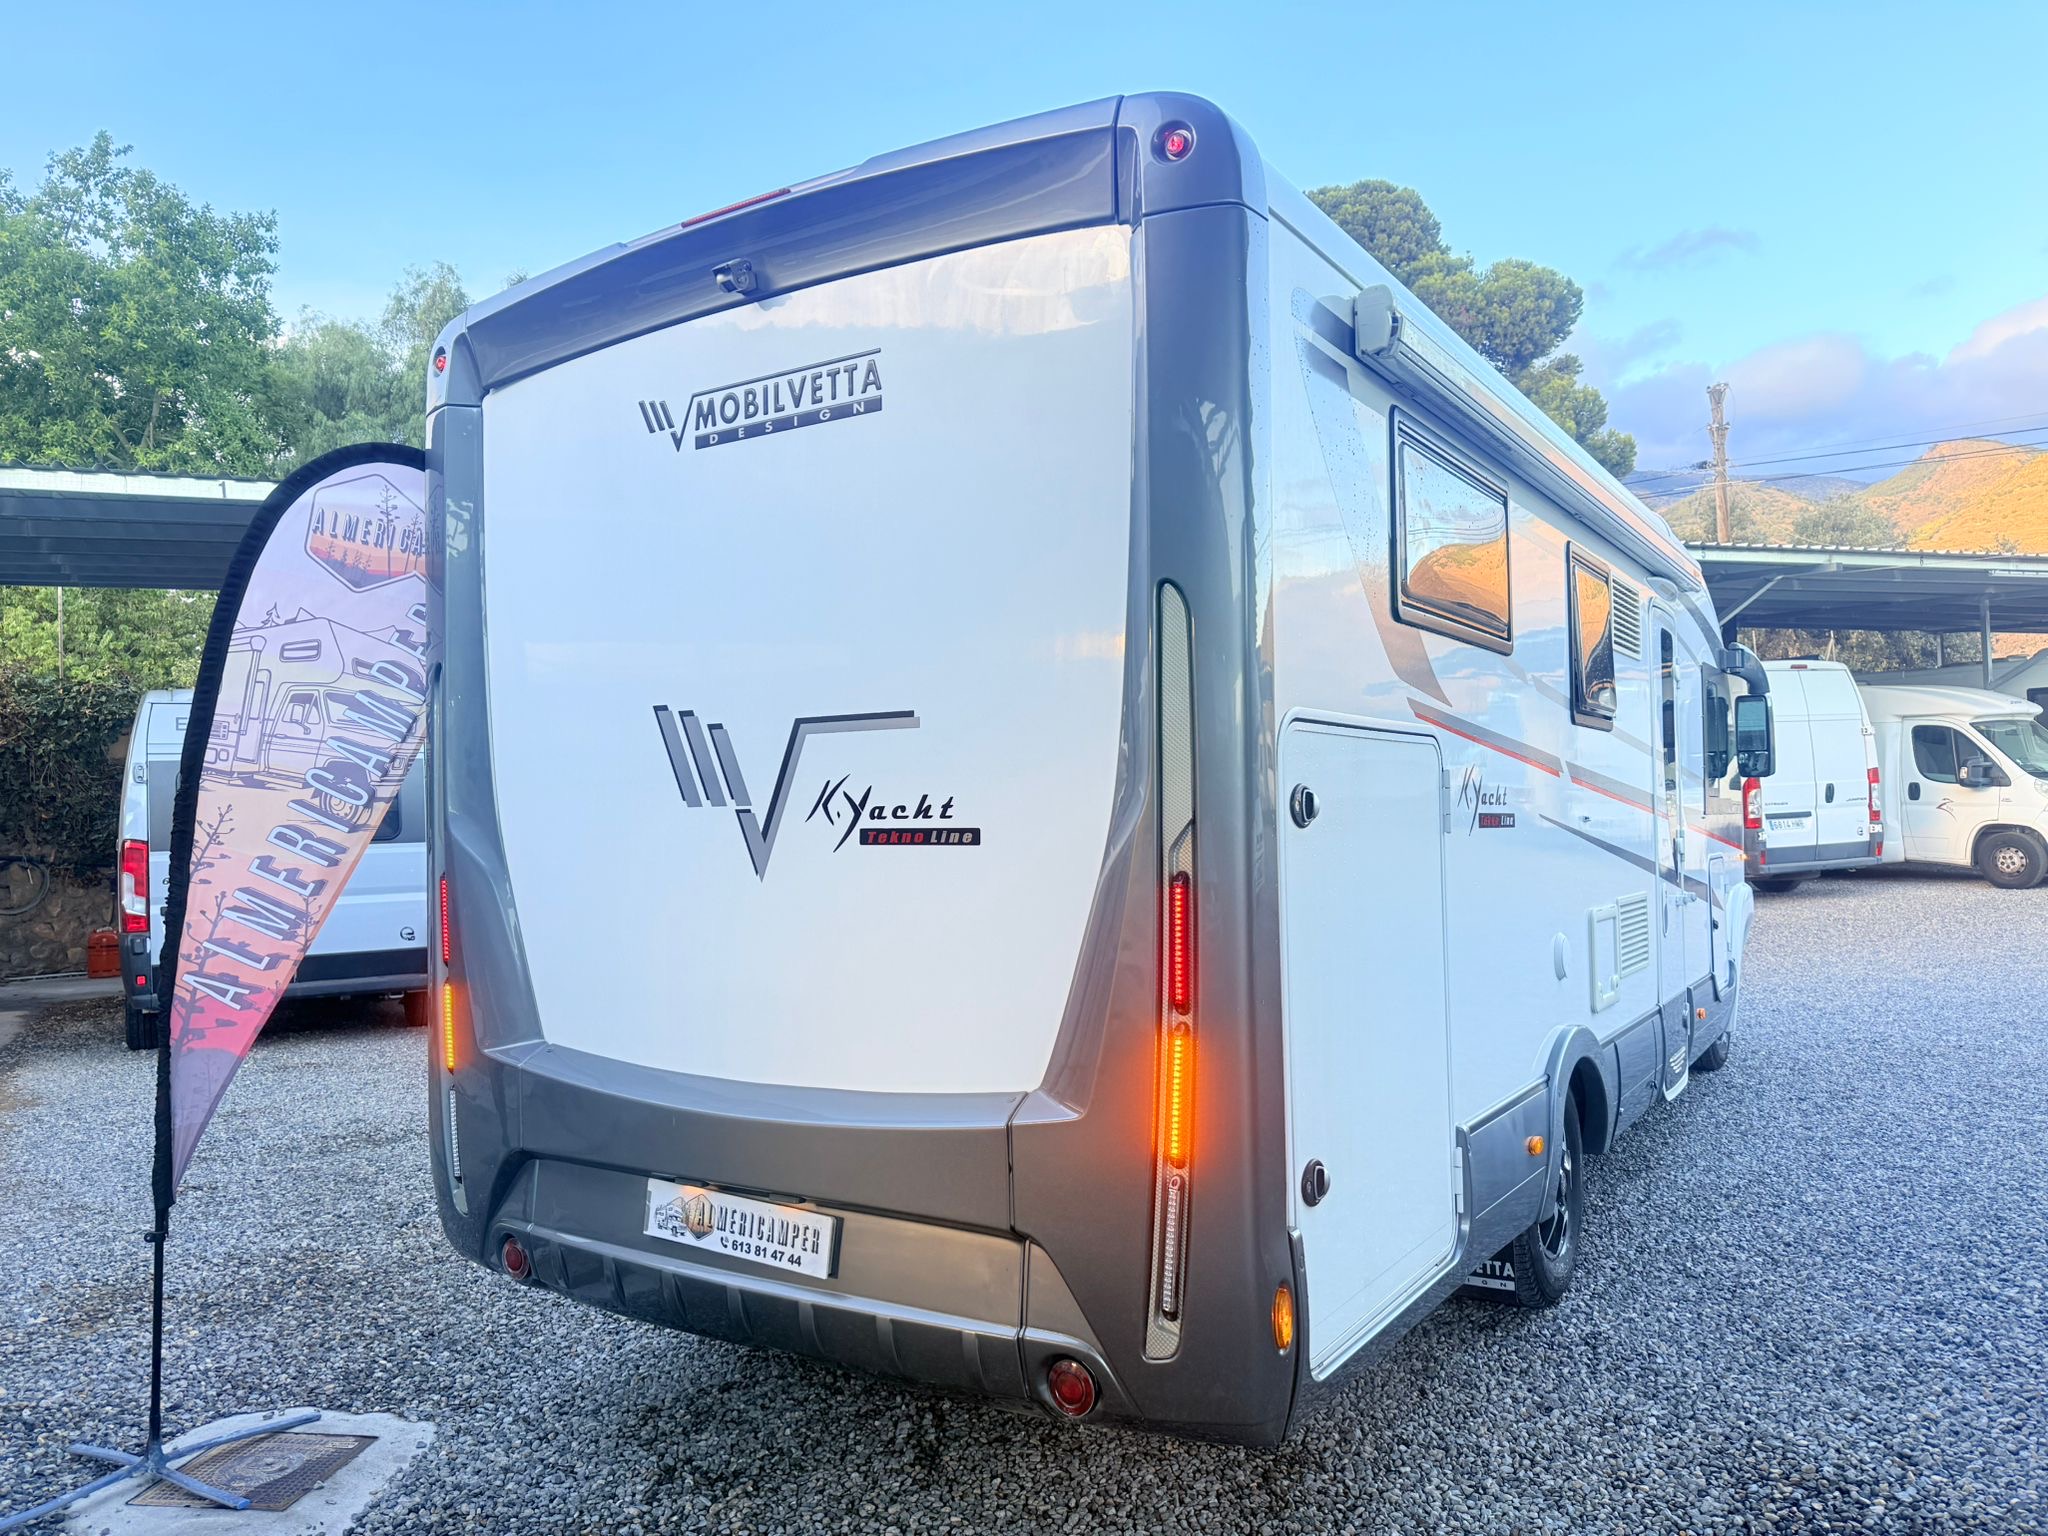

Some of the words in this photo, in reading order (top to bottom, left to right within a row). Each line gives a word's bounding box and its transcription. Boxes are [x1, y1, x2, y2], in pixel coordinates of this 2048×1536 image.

[694, 358, 883, 432] MOBILVETTA
[709, 401, 865, 445] DESIGN
[312, 507, 426, 558] ALMERICA
[175, 716, 188, 731] E
[867, 831, 925, 844] Tekno
[929, 830, 973, 844] Line
[698, 1200, 821, 1255] ALMERICAMPER
[731, 1239, 752, 1254] 613
[754, 1245, 767, 1259] 81
[770, 1250, 785, 1263] 47
[787, 1253, 802, 1267] 44
